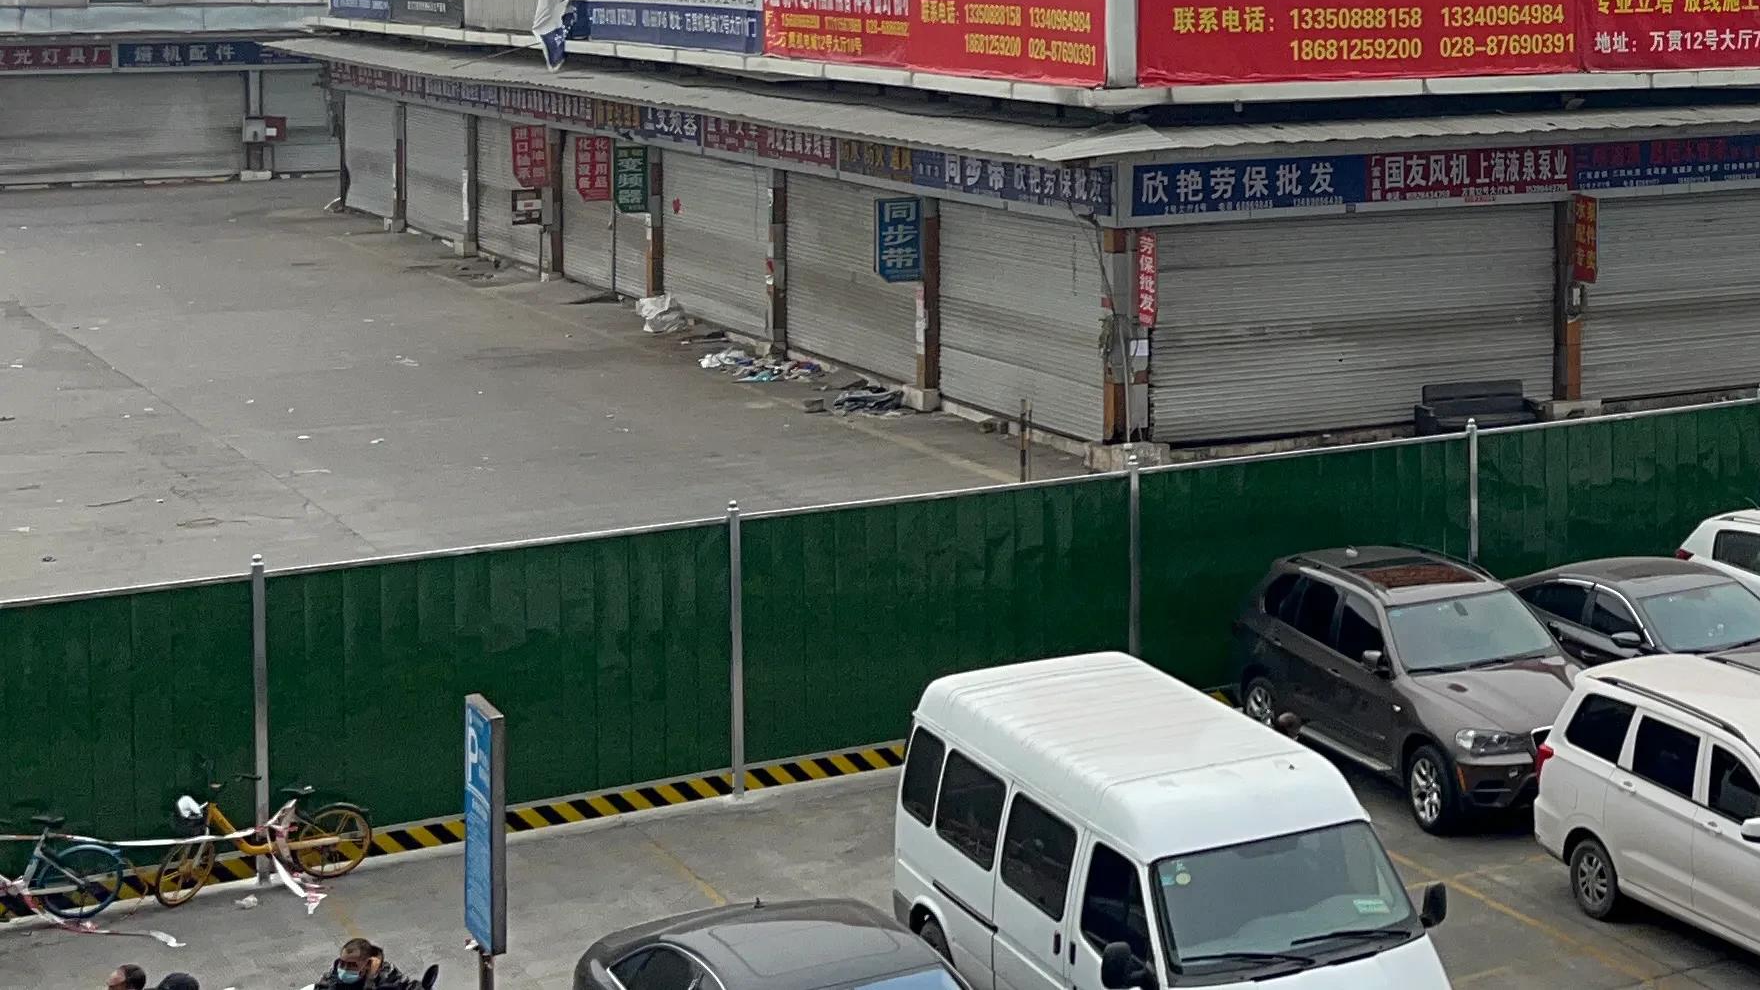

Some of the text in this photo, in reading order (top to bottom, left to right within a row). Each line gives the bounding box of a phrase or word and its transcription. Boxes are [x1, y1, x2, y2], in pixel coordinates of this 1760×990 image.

[1290, 8, 1422, 30] 13350888158
[1441, 5, 1565, 27] 13340964984
[0, 45, 110, 66] 光灯具厂
[1290, 34, 1575, 61] 18681259200 028-87690391
[946, 154, 1005, 191] 同步带
[1141, 162, 1335, 204] 欣艳劳保批发
[1385, 153, 1470, 189] 国友风机
[1476, 148, 1568, 184] 上海液泉泵业
[882, 202, 918, 268] 同步带
[1139, 236, 1155, 313] 劳保批发
